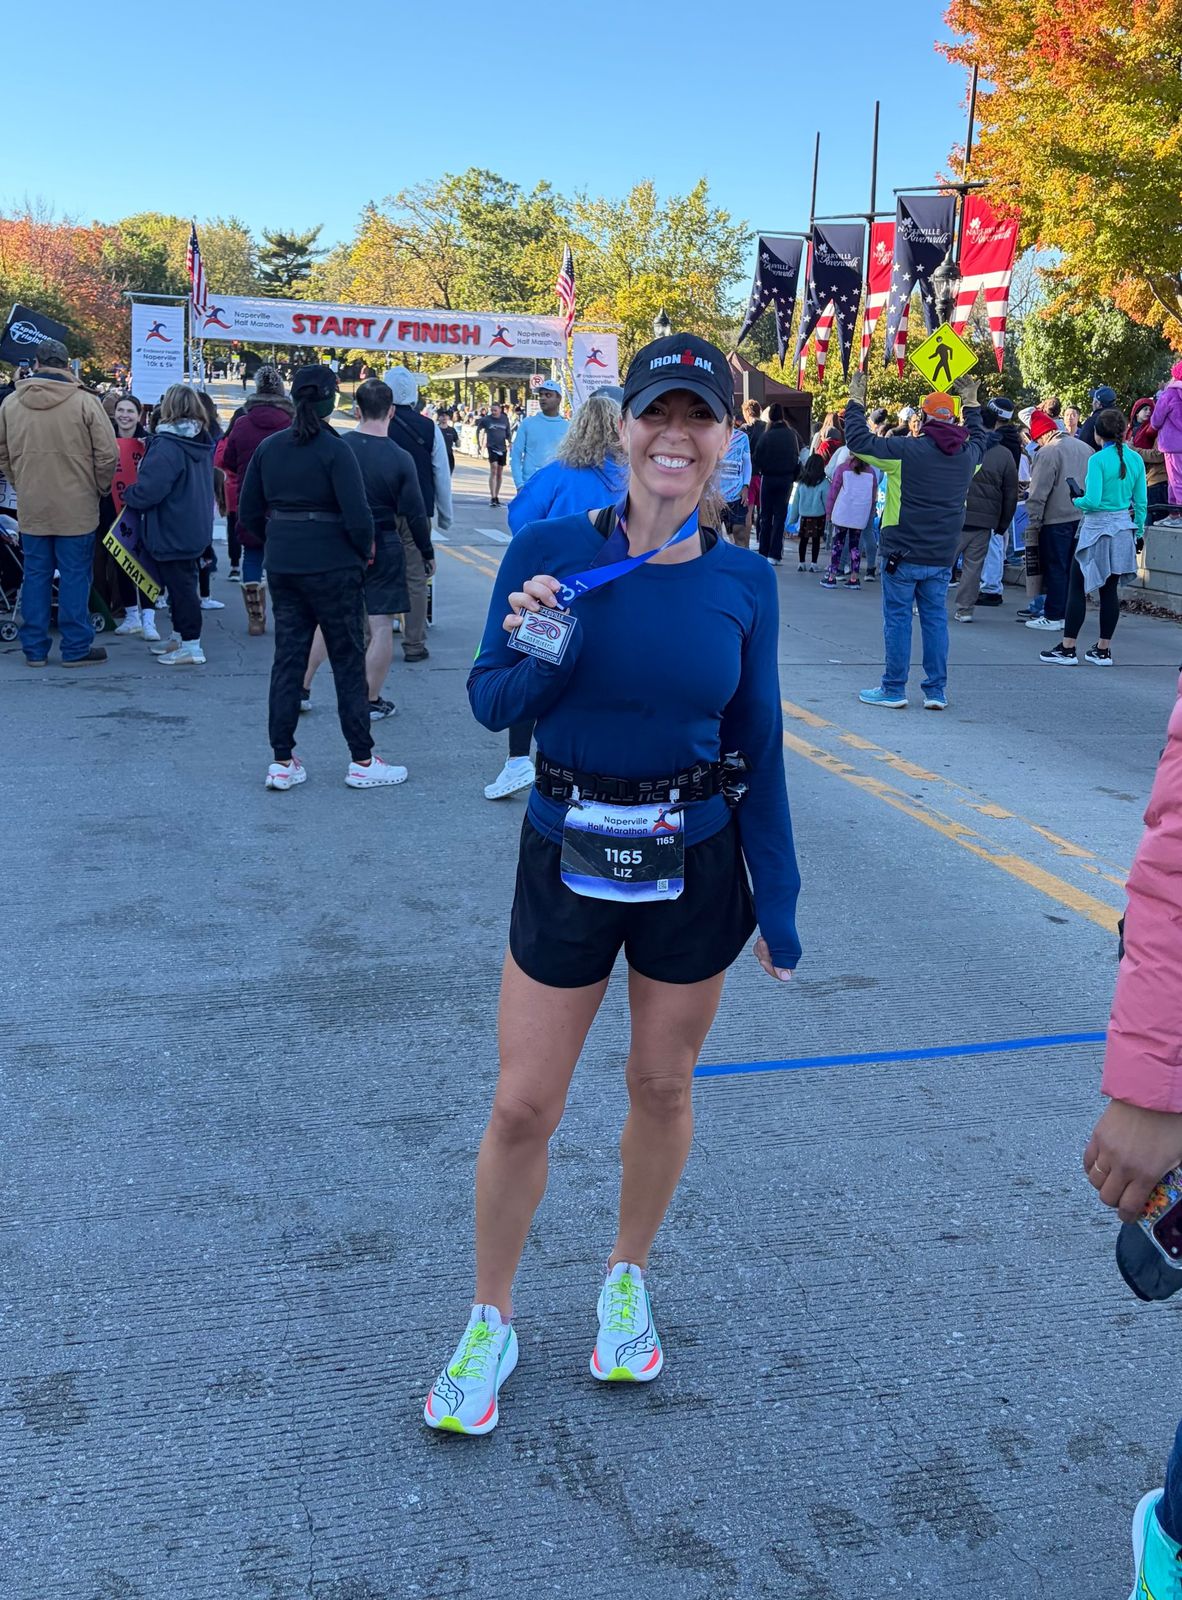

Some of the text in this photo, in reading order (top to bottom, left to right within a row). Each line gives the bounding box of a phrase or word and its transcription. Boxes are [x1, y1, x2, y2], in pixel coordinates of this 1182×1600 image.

[234, 311, 271, 320] Naperville
[234, 319, 284, 329] Half Marathon
[292, 313, 480, 346] START / FINISH
[517, 330, 551, 338] Naperville
[517, 338, 562, 348] Half Marathon
[650, 349, 714, 374] IRONMAN
[105, 536, 113, 548] R
[113, 546, 122, 557] U
[122, 555, 145, 585] THAT
[526, 616, 561, 640] 250
[519, 645, 558, 662] HALF MARATHON
[604, 816, 648, 826] Naperville
[588, 823, 648, 835] Half Marathon
[656, 836, 674, 846] 1165
[605, 848, 643, 864] 1165
[613, 868, 632, 878] LIZ
